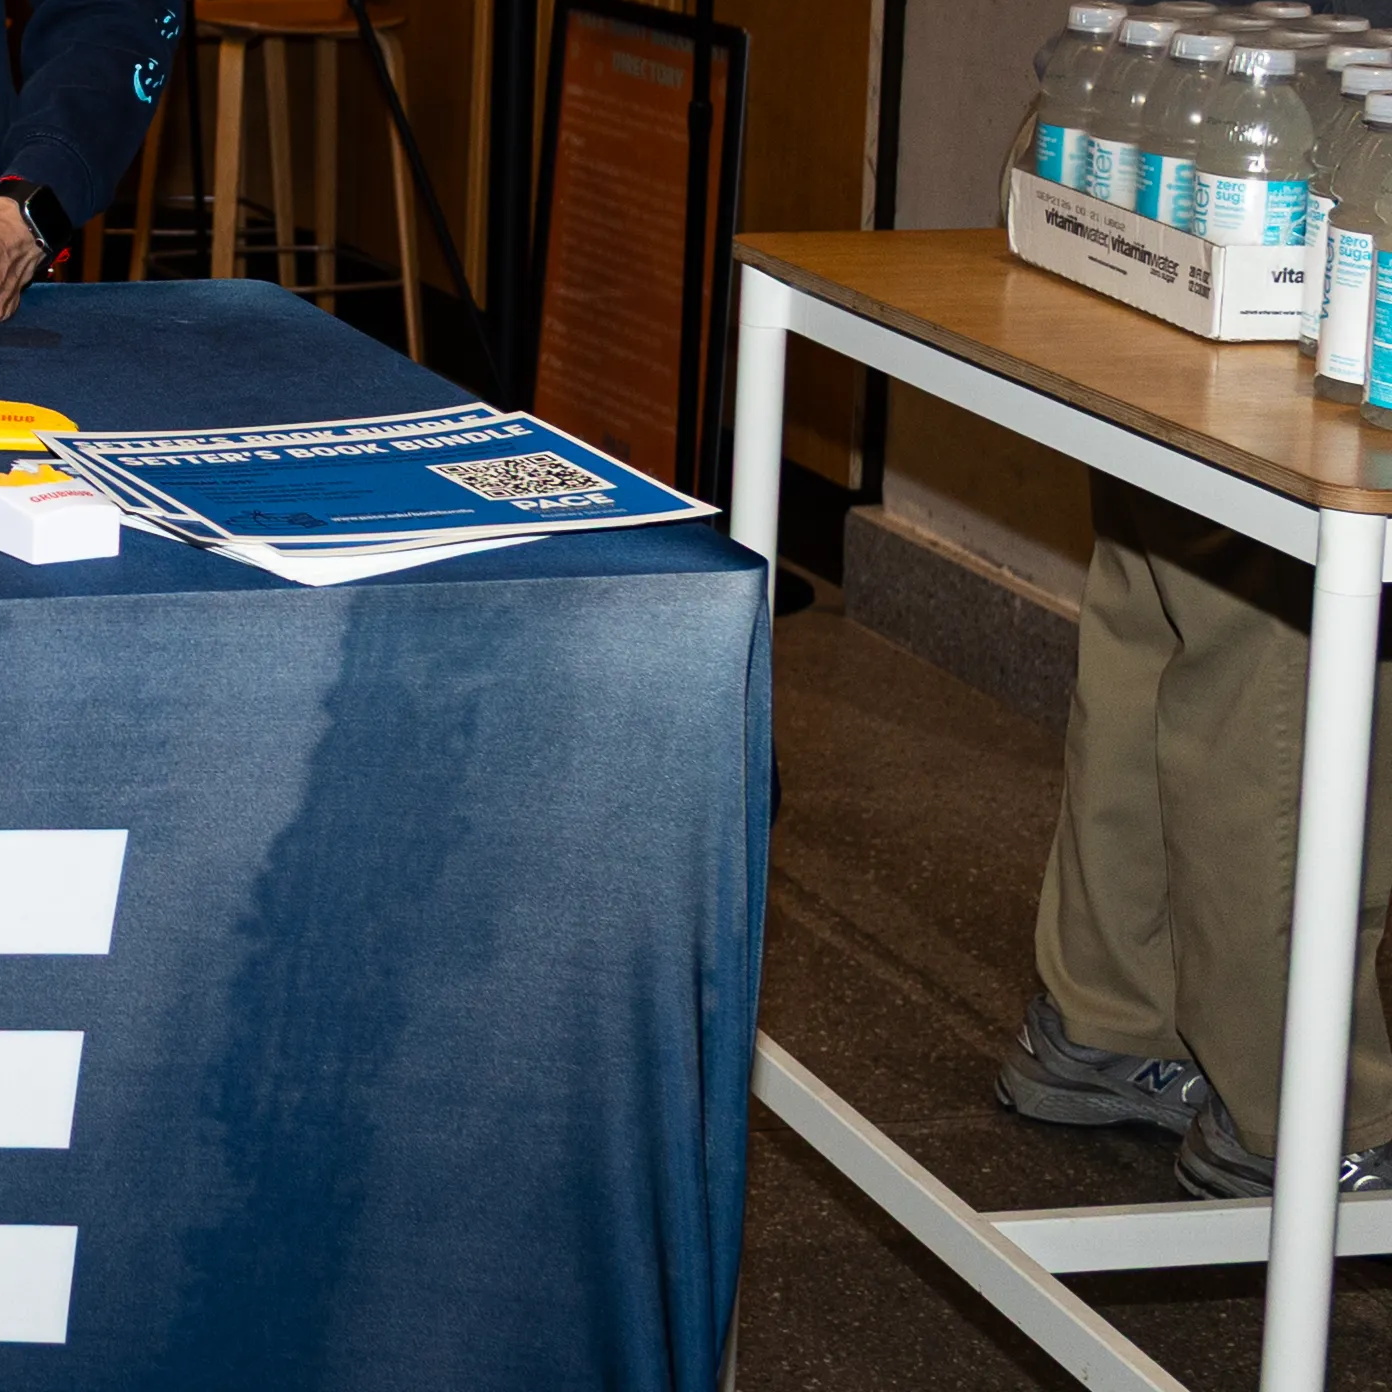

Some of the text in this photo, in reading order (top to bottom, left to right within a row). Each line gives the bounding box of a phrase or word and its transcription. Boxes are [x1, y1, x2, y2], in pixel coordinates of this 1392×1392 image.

[1044, 207, 1108, 249] vitaminwater
[1110, 234, 1180, 278] vitaminwater
[1340, 234, 1368, 249] zero
[1339, 248, 1373, 262] suga
[117, 448, 281, 467] SETTER'S
[284, 441, 390, 461] BOOK
[389, 423, 535, 452] BUNDLE
[30, 491, 95, 505] GRUBHUB
[509, 492, 616, 511] PACE
